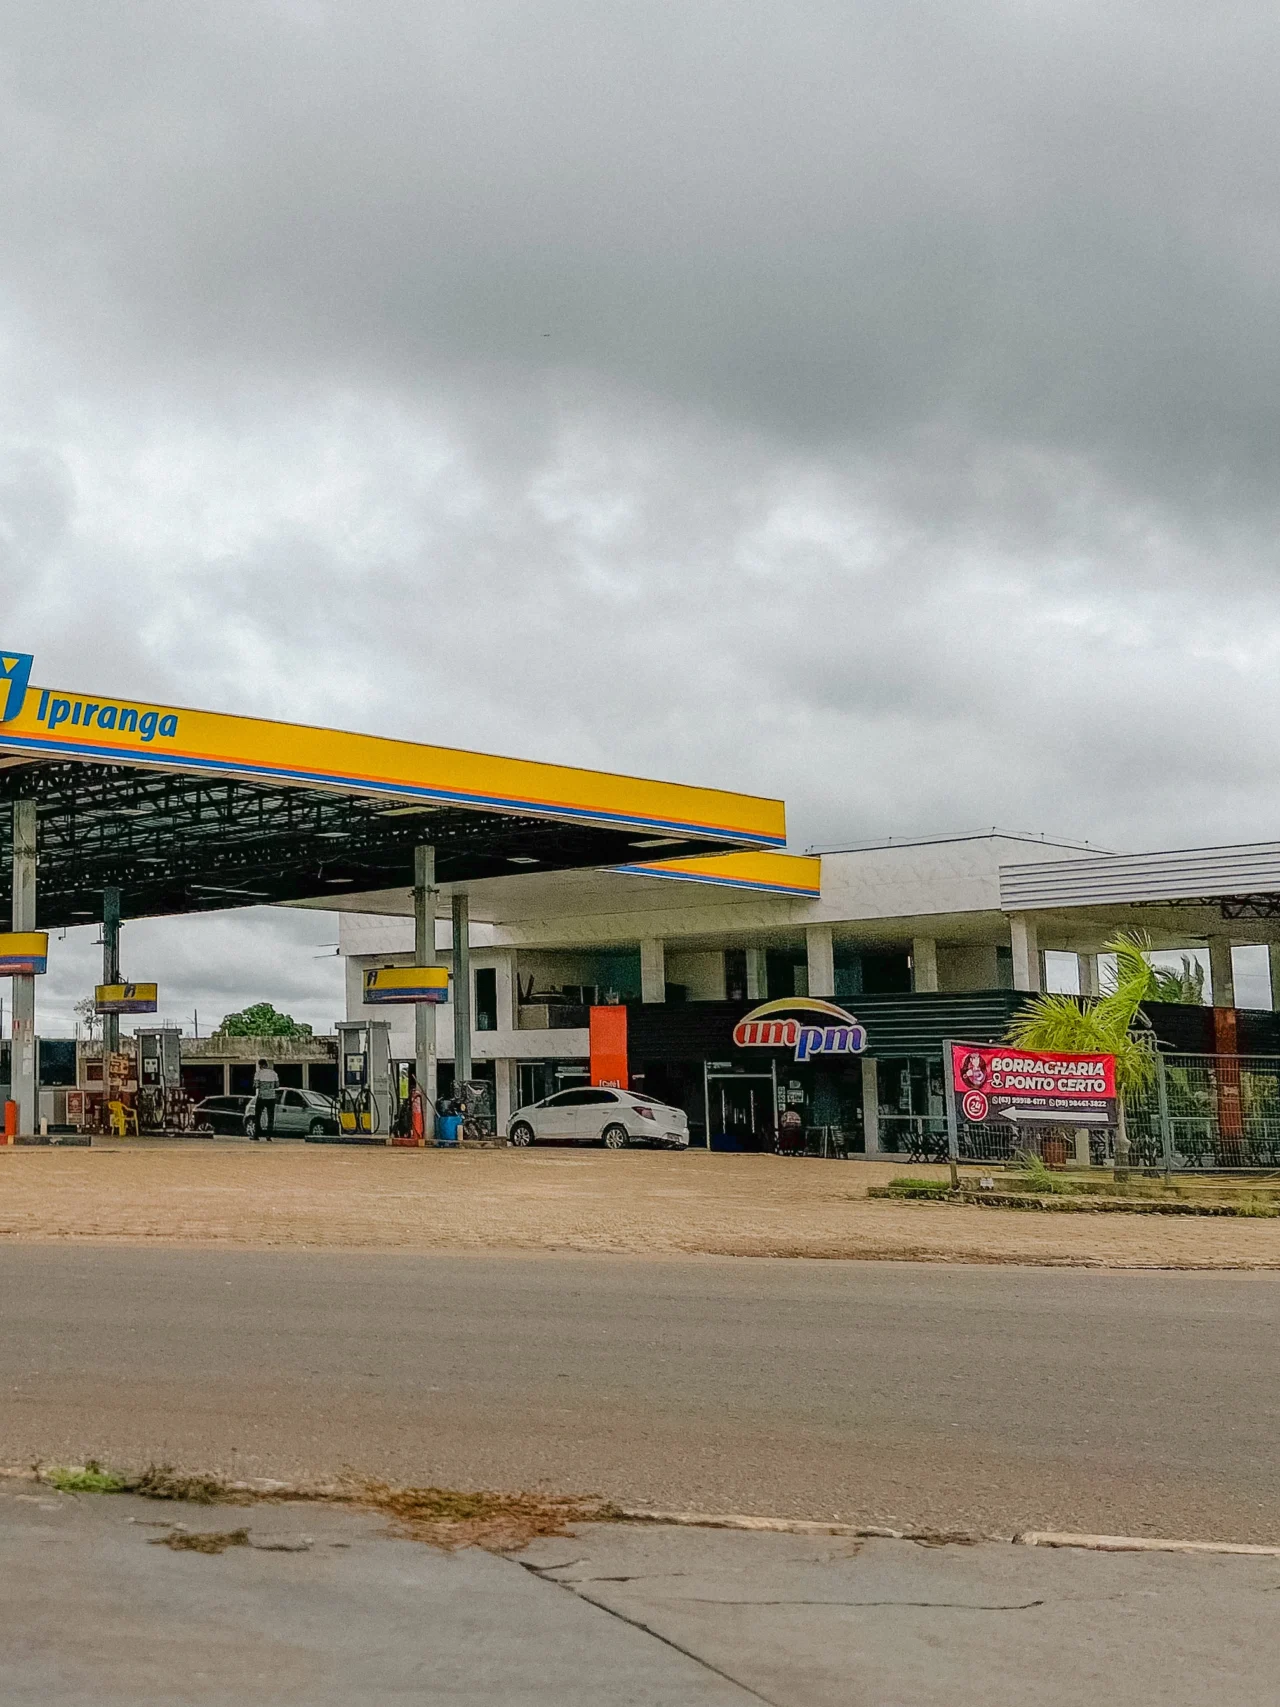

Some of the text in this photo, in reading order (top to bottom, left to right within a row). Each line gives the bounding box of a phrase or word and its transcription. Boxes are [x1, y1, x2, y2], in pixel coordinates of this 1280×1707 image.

[37, 690, 179, 742] Ipiranga
[991, 1057, 1105, 1076] BORRACHARIA
[1004, 1075, 1107, 1092] PONTO CERTO
[970, 1101, 981, 1109] 24
